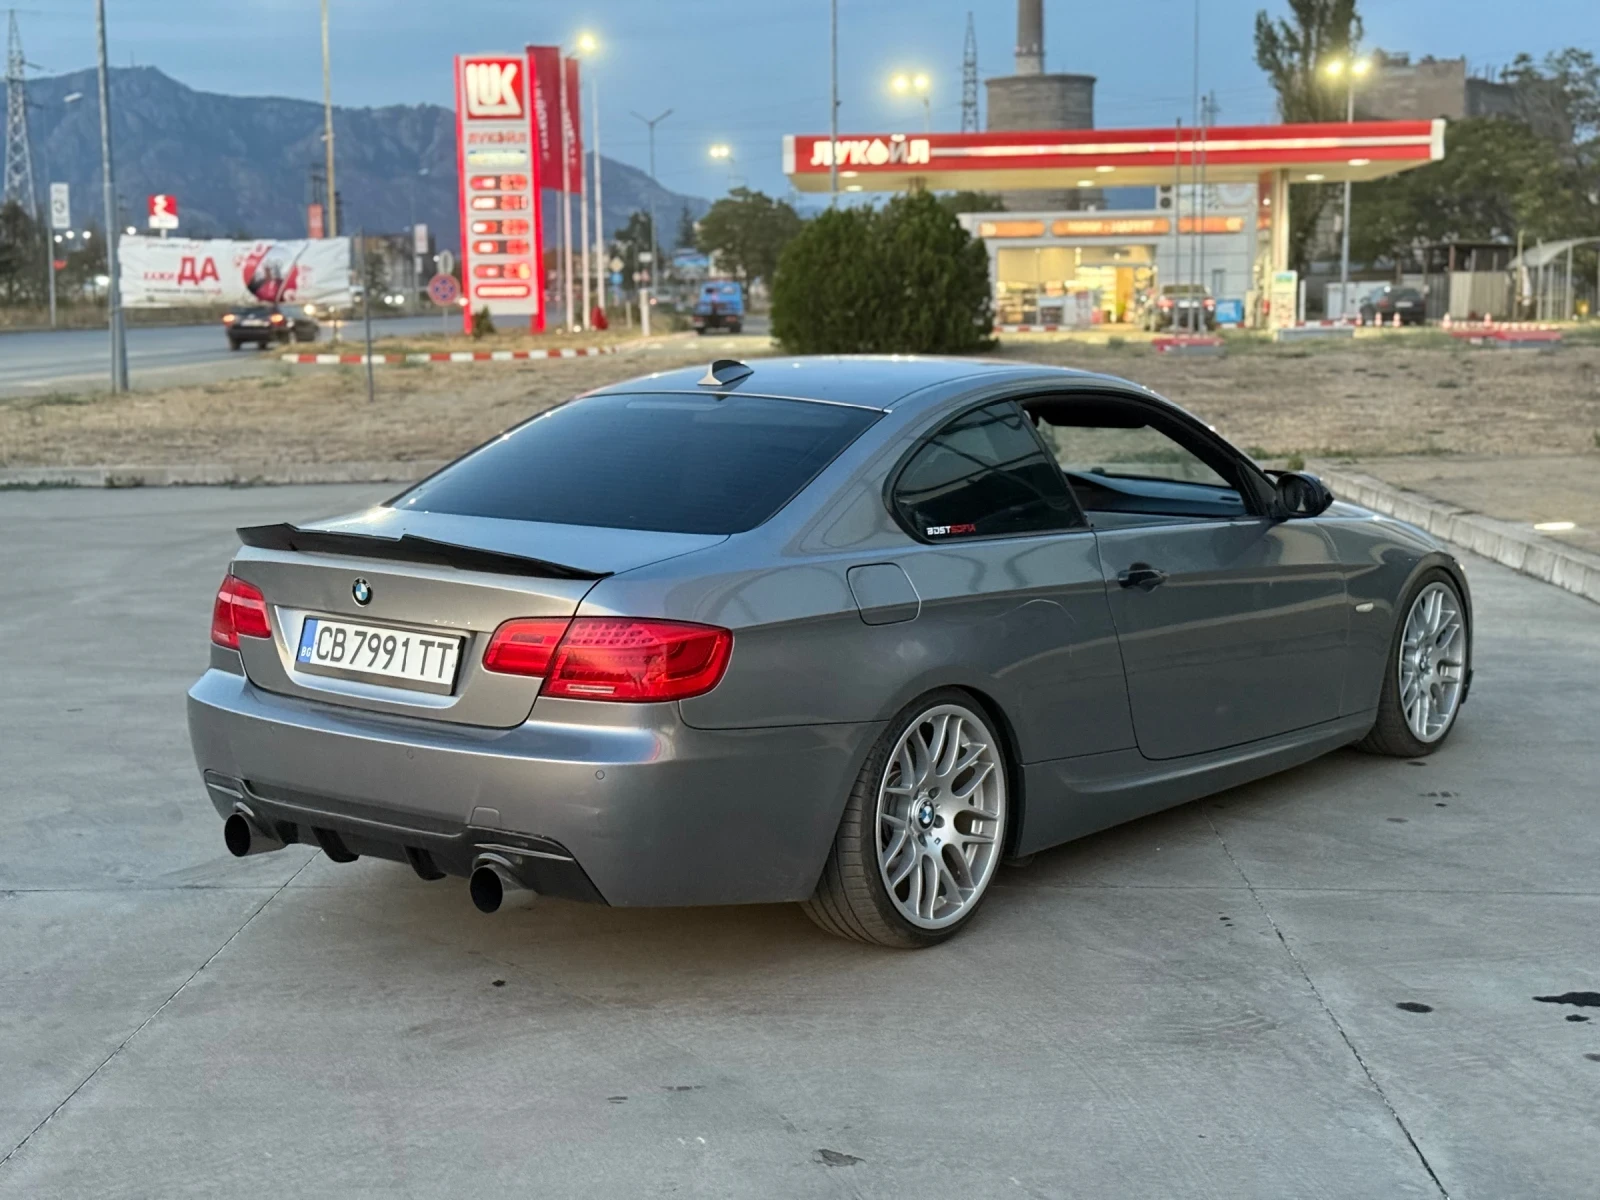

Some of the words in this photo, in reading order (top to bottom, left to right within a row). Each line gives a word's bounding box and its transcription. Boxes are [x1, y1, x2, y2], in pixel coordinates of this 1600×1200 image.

[810, 133, 930, 167] ЛУКОЙЛ
[177, 256, 220, 285] ДА
[316, 626, 347, 662] CB
[349, 630, 410, 673] 7991
[419, 639, 454, 679] TT
